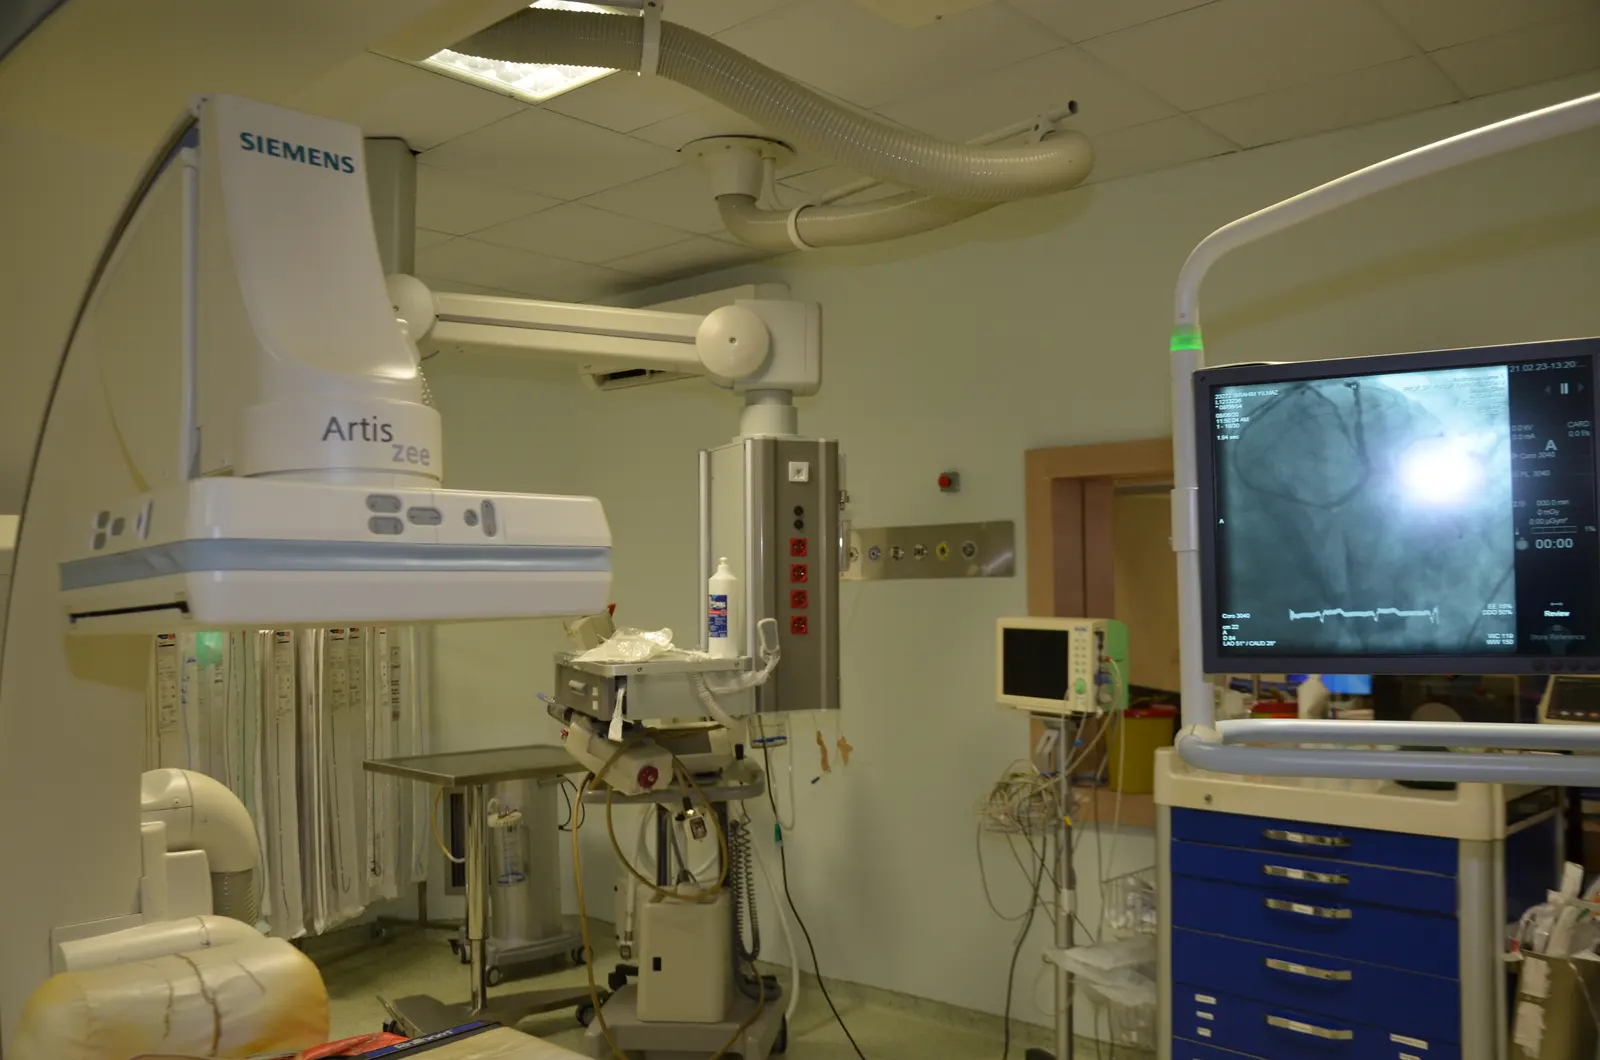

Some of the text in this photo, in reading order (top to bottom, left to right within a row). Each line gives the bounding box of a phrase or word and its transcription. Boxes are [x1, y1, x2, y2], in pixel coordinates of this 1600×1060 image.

[240, 131, 355, 174] SIEMENS
[322, 415, 394, 443] Artis
[392, 443, 430, 467] zee
[1545, 439, 1558, 451] A
[1535, 538, 1574, 549] 00:00
